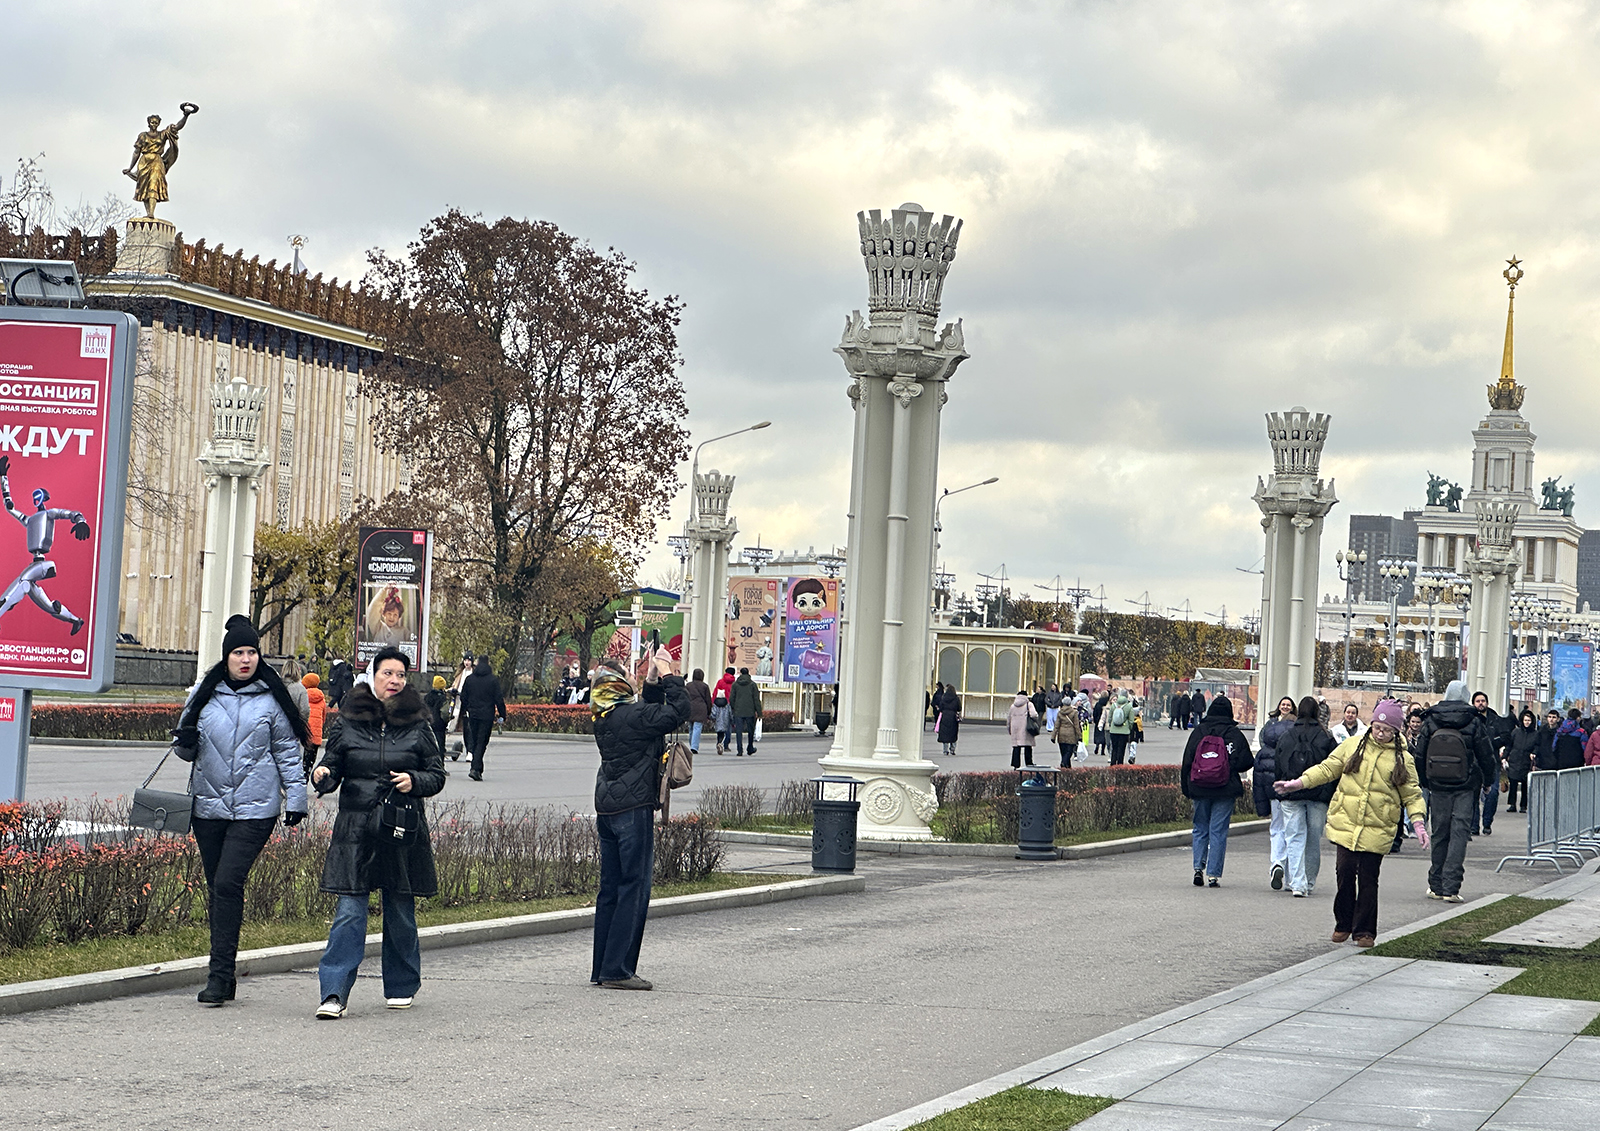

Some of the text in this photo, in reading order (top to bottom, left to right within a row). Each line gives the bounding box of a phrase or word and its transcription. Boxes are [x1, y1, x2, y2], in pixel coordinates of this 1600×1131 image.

[85, 346, 106, 354] ВДНХ
[0, 383, 92, 401] ОСТАНЦИЯ
[21, 405, 61, 414] ВЫСТАВКА
[62, 407, 97, 416] РОБОТОВ
[0, 424, 94, 458] ЖДУТ
[368, 562, 416, 573] «СЫРОВАРНЯ»
[744, 590, 763, 600] ГОРОД
[410, 632, 418, 641] 6+
[740, 626, 753, 638] 30
[20, 655, 56, 663] ПАВИЛЬОН
